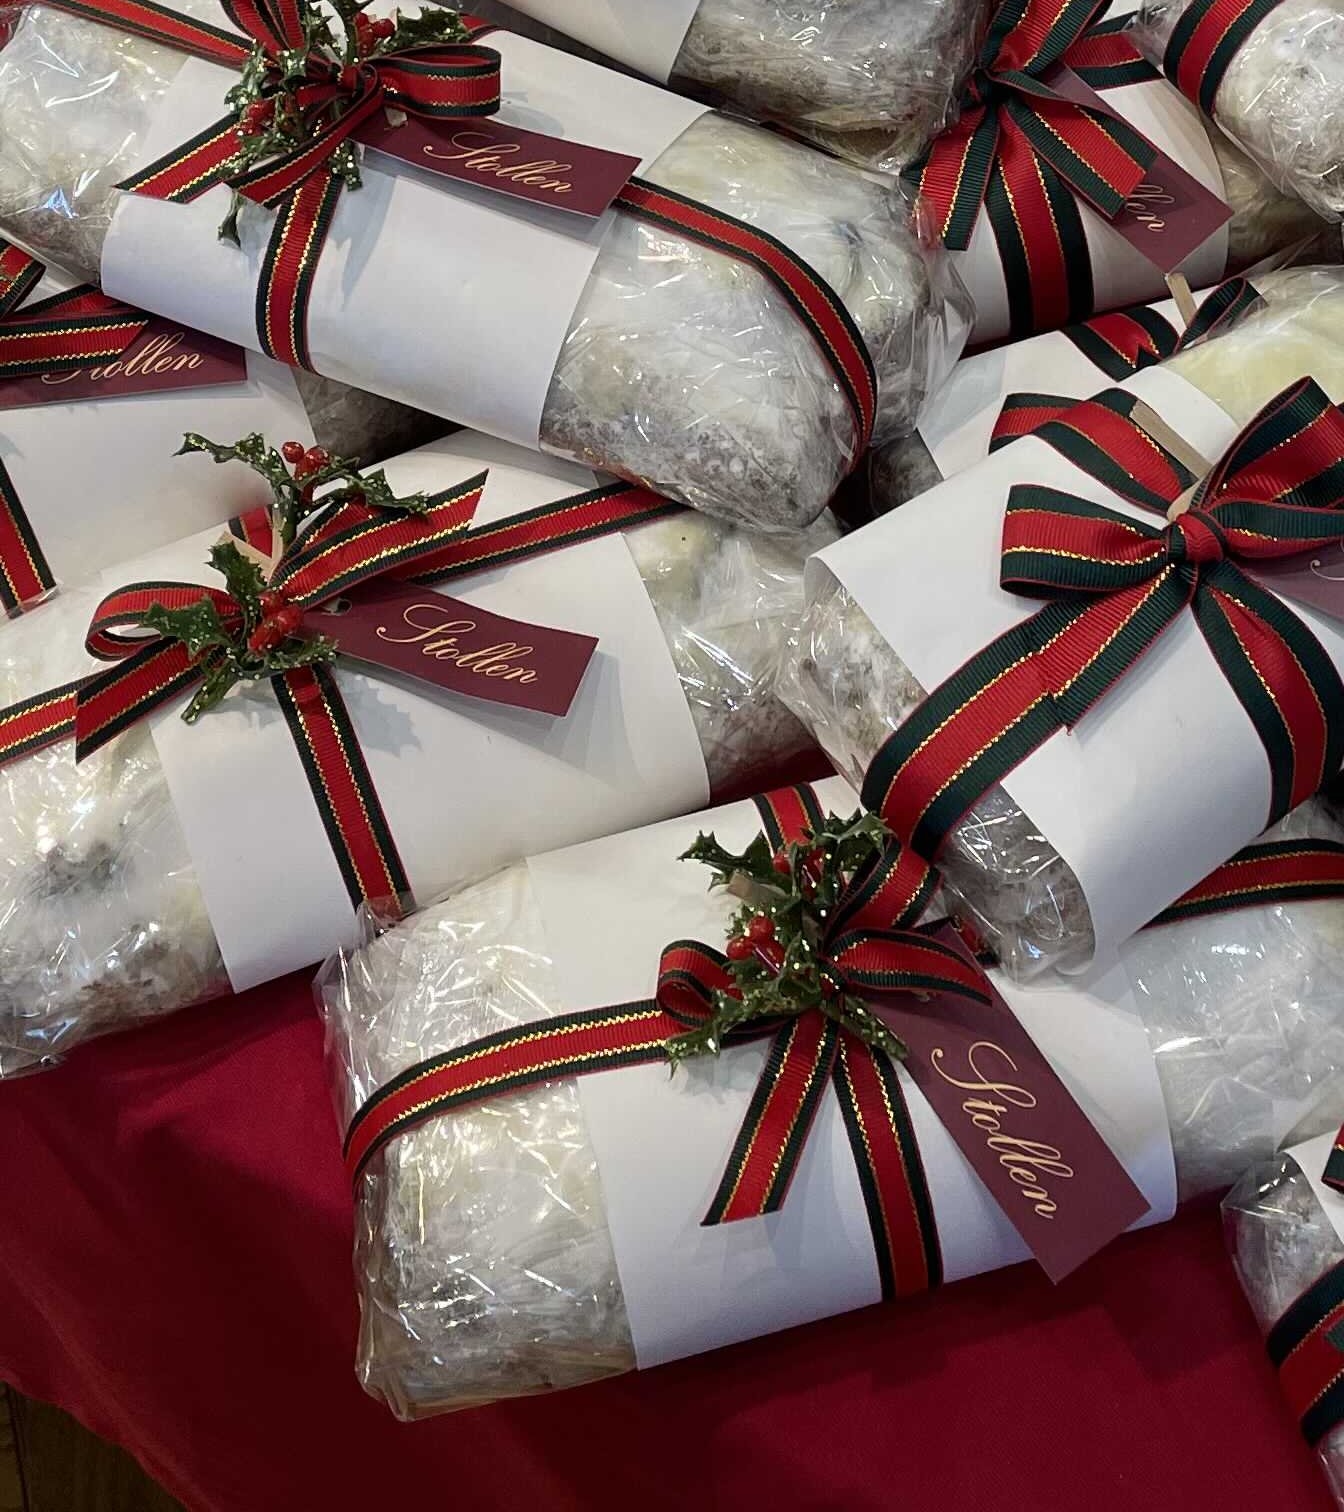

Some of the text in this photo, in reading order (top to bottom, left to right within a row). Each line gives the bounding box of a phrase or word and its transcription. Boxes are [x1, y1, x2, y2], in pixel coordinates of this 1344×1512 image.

[423, 131, 573, 193] Stollen
[376, 603, 539, 684] Stollen
[931, 1040, 1074, 1220] Stollen
